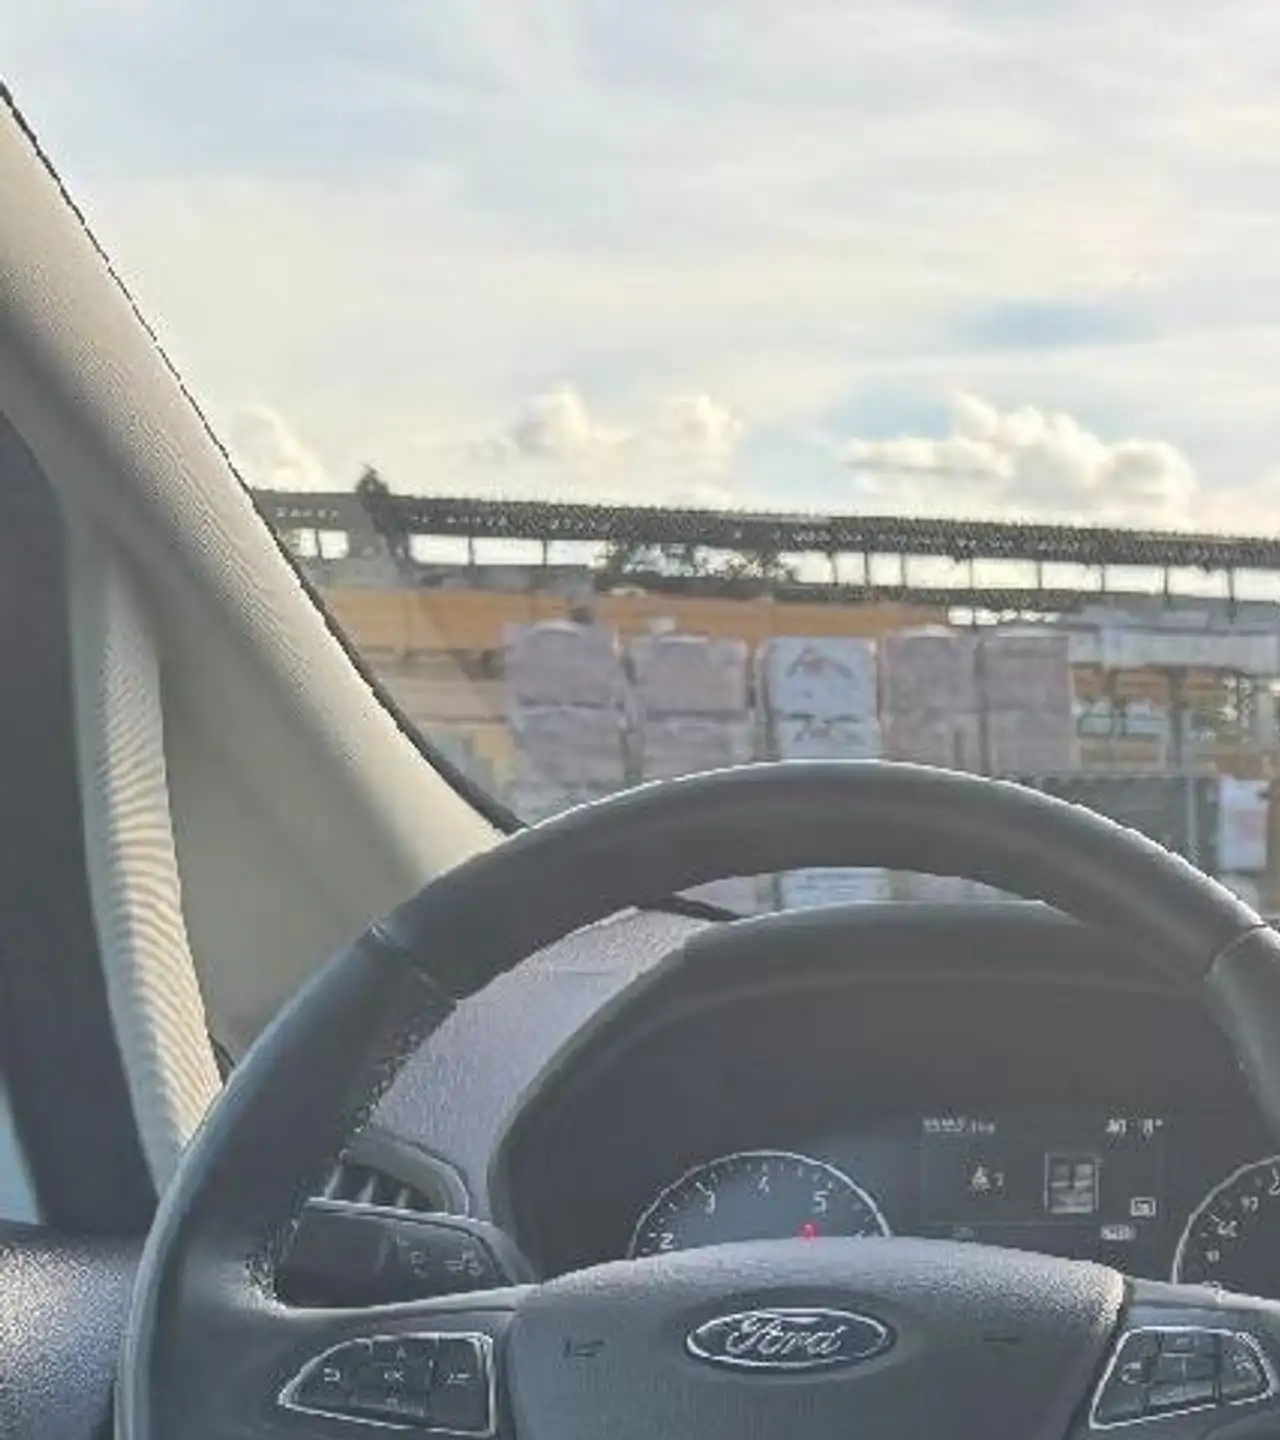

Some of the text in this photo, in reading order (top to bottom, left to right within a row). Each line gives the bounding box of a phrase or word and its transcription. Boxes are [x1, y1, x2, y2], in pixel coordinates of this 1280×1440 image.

[813, 1190, 828, 1213] 5
[660, 1232, 675, 1250] 2
[725, 1312, 848, 1355] Ford
